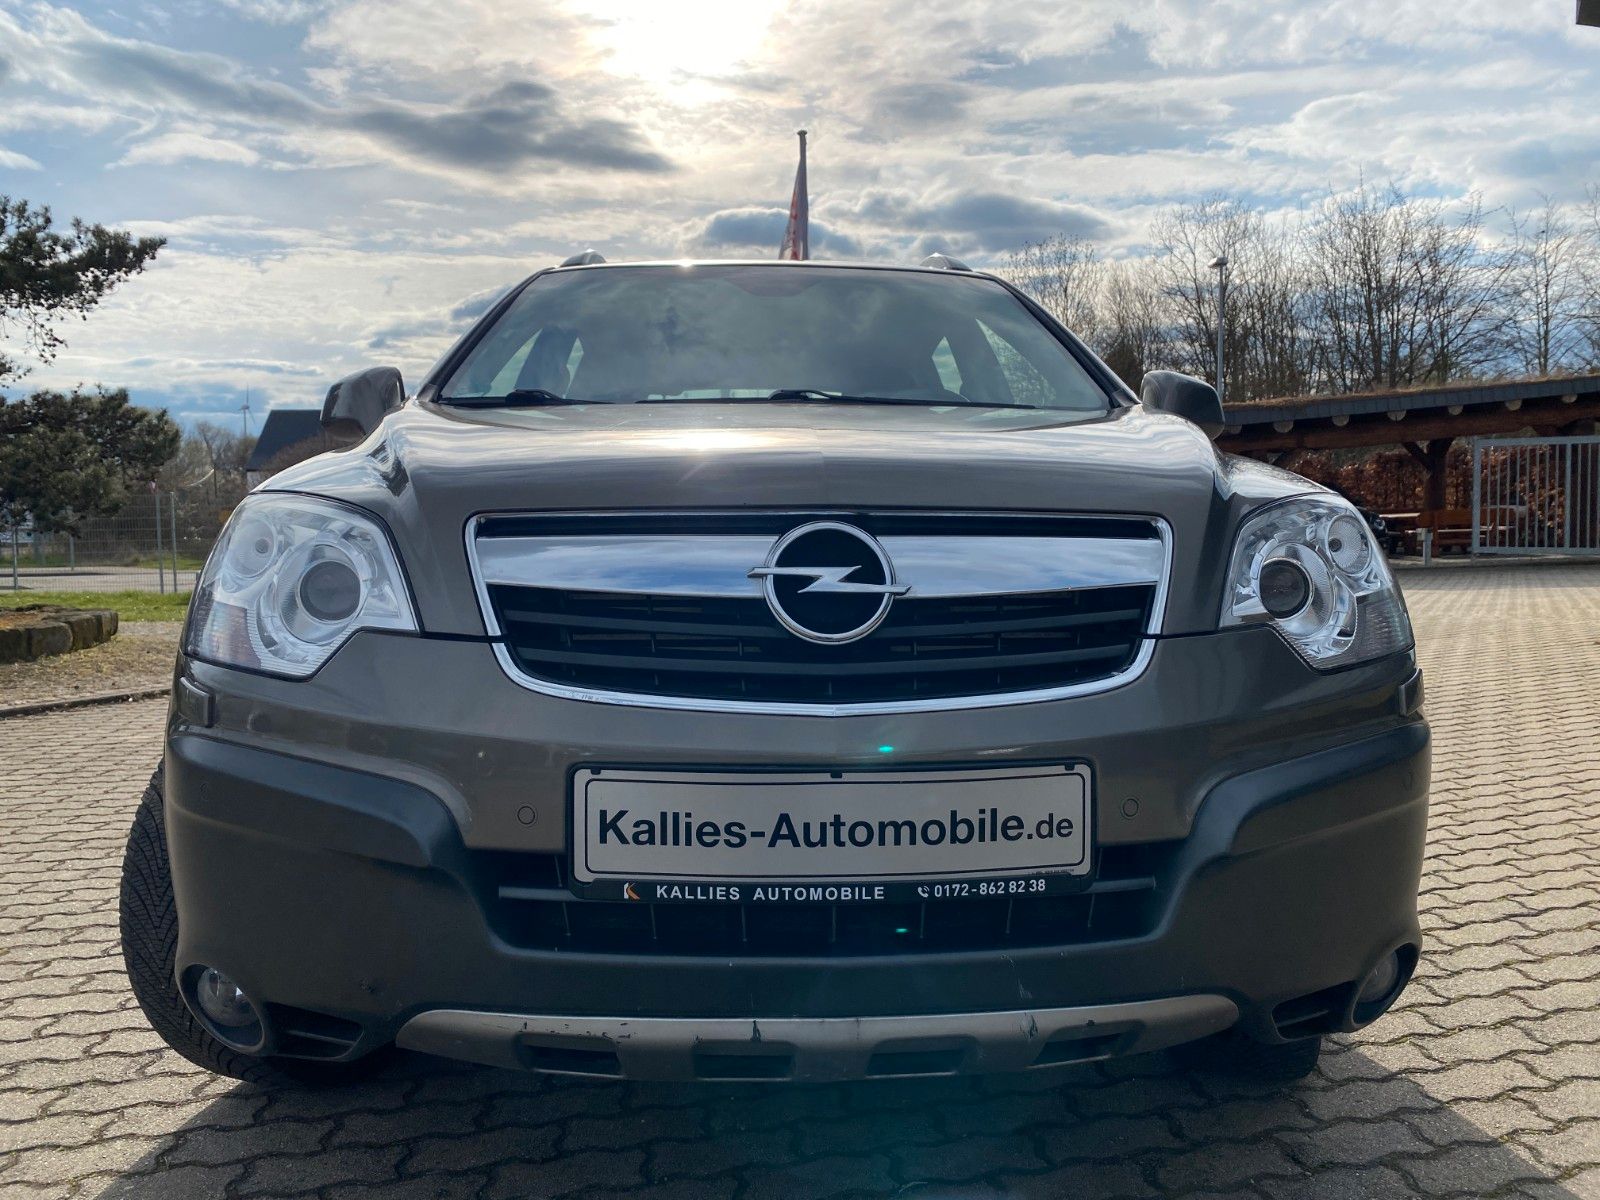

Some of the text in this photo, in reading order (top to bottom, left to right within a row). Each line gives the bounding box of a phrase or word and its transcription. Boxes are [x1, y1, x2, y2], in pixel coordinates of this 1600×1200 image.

[599, 808, 1074, 848] Kallies-Automobile.de
[656, 885, 885, 901] KALLIES AUTOMOBILE
[934, 878, 1046, 898] 0172-862 82 38
